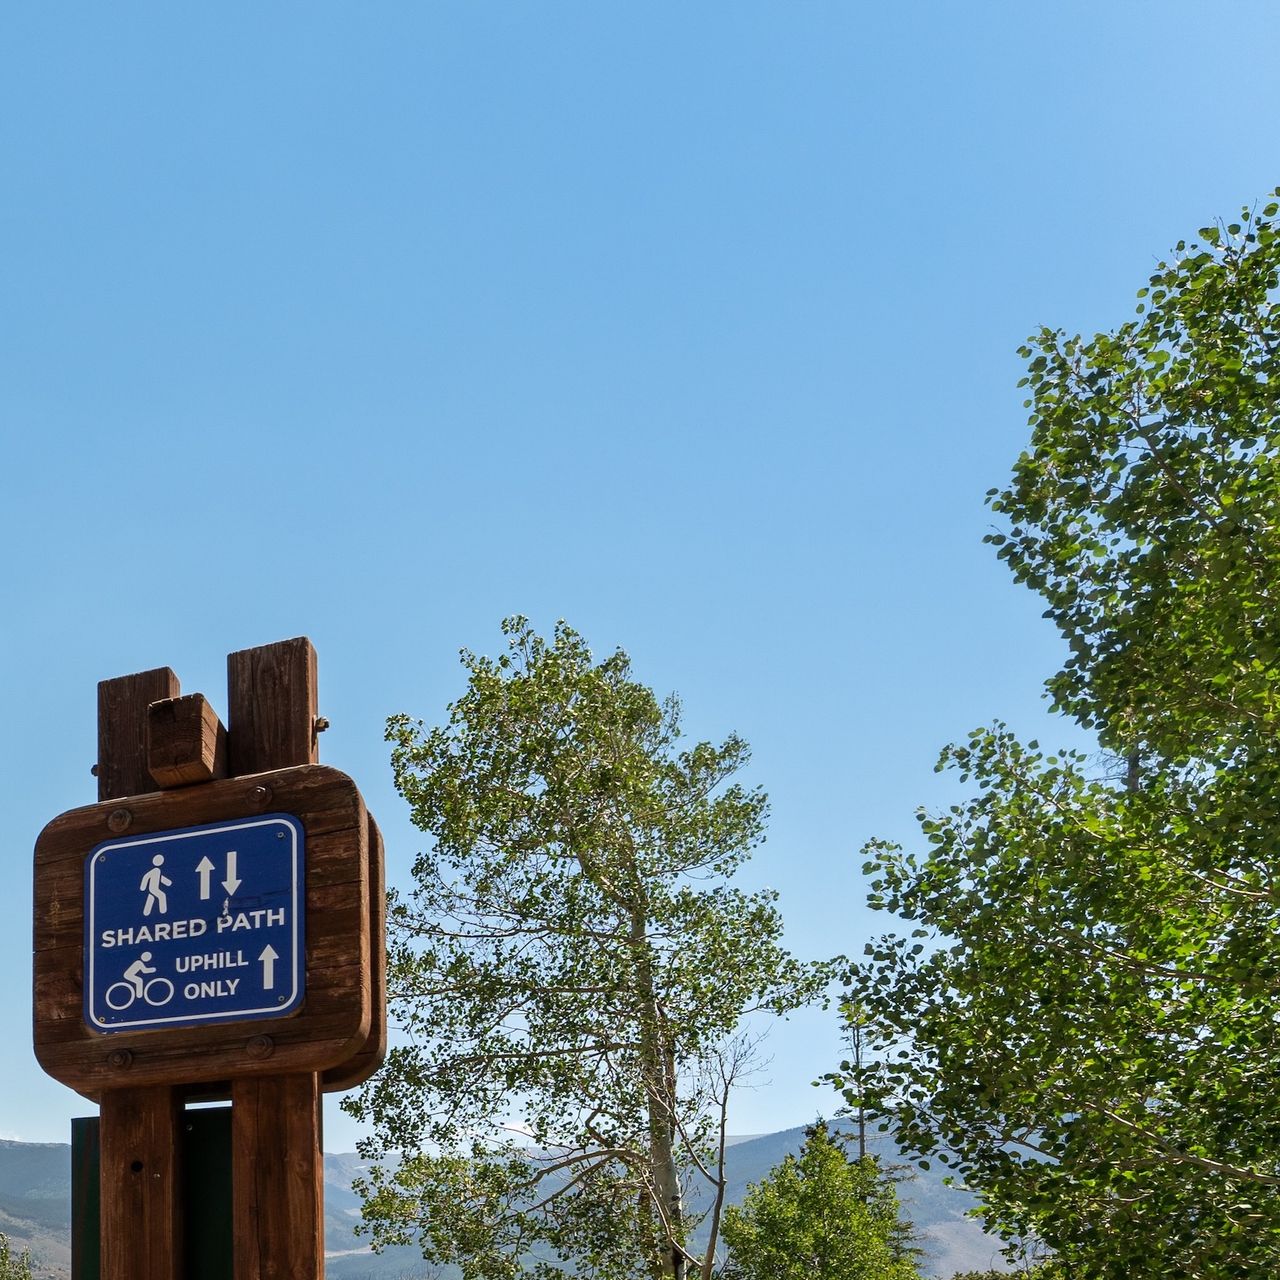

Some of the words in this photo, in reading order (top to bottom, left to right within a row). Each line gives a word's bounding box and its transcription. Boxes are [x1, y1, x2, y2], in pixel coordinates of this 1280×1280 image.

[101, 918, 207, 948] SHARED
[217, 908, 285, 933] PATH
[175, 950, 249, 973] UPHILL
[183, 978, 241, 1000] ONLY
